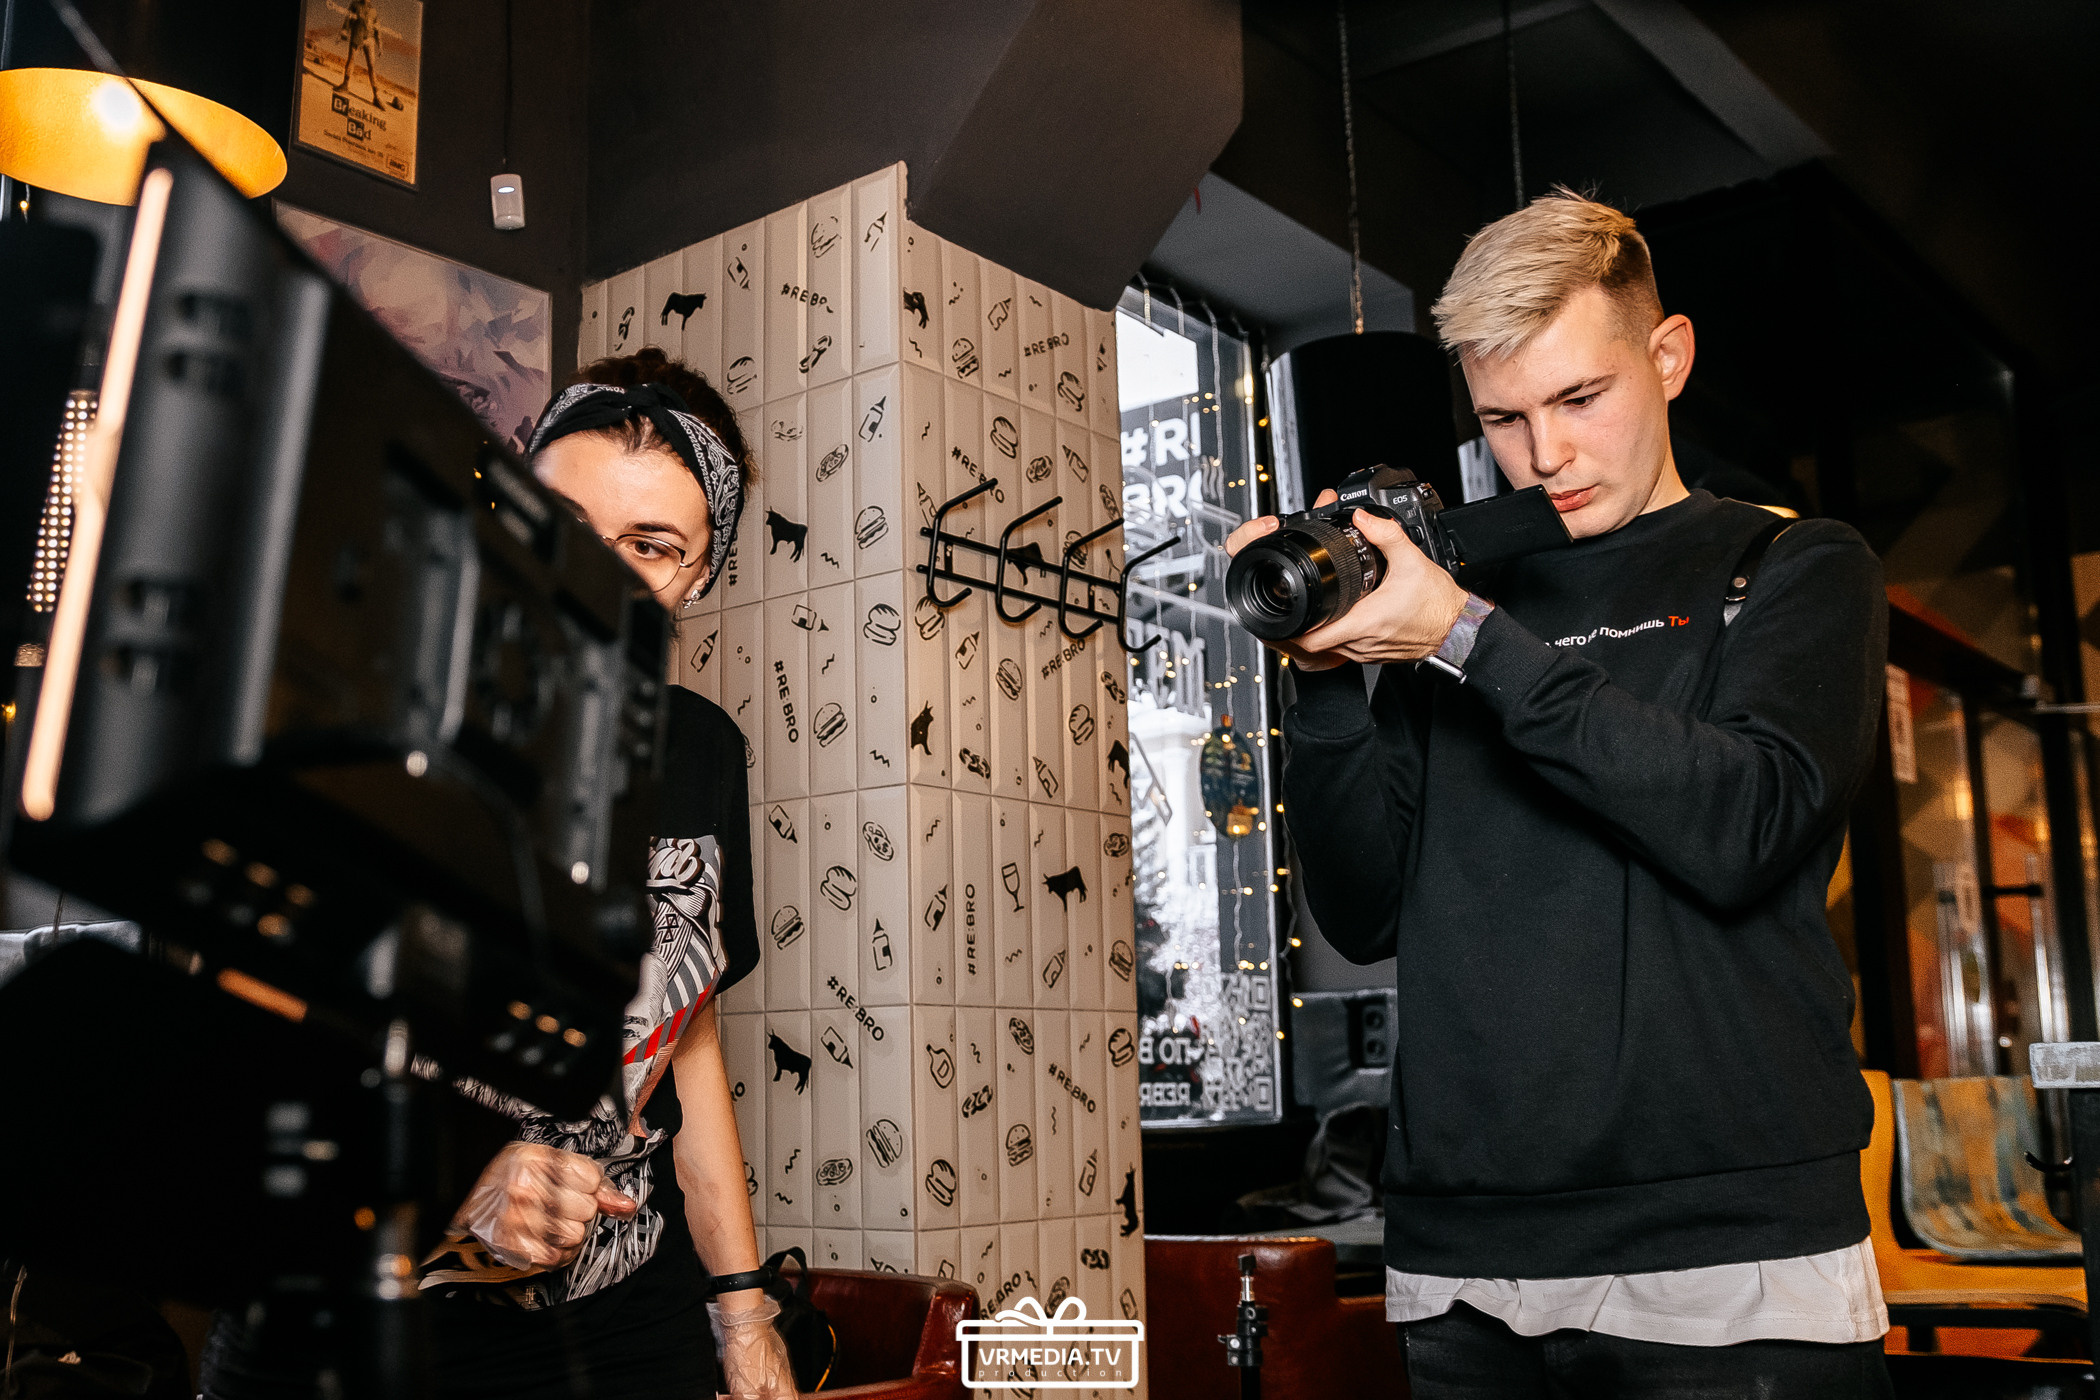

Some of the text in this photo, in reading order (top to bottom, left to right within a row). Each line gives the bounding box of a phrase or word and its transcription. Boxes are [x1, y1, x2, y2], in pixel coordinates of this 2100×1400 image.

[332, 93, 387, 132] Breaking
[347, 119, 370, 141] Bad
[1340, 488, 1367, 502] Canon
[1392, 494, 1408, 505] EOS
[1554, 634, 1587, 647] чего
[1599, 618, 1665, 638] помнишь
[1668, 615, 1690, 627] Ты
